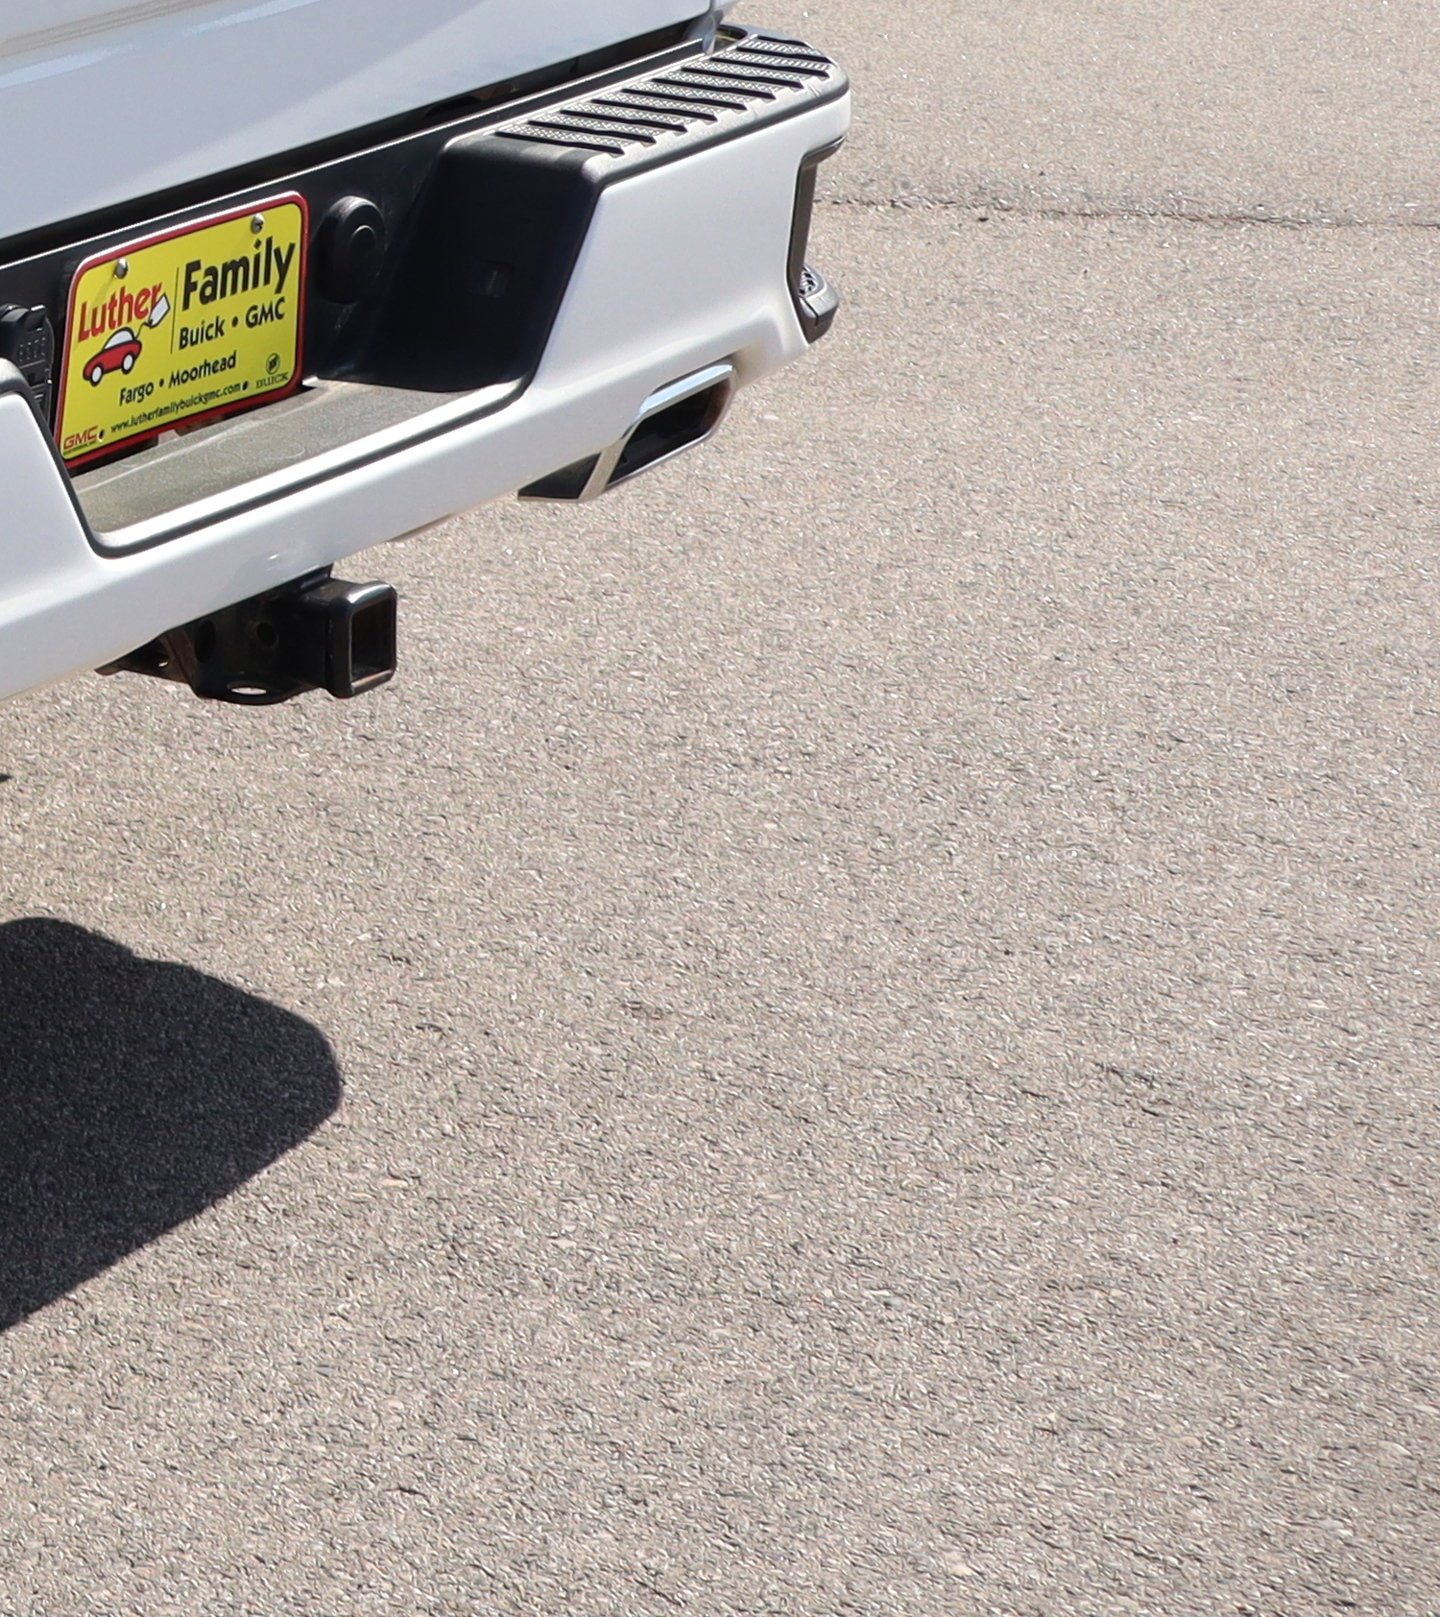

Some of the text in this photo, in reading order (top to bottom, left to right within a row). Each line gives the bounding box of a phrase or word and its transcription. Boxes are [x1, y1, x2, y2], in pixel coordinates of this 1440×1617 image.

[182, 236, 296, 312] Family
[78, 282, 162, 343] Luther
[179, 296, 286, 351] Buick GMC
[119, 350, 238, 407] Fargo Moorhead
[255, 372, 290, 390] BUICK
[110, 382, 242, 434] www.lutherfamilybuickgmc.com
[63, 425, 98, 450] GMC
